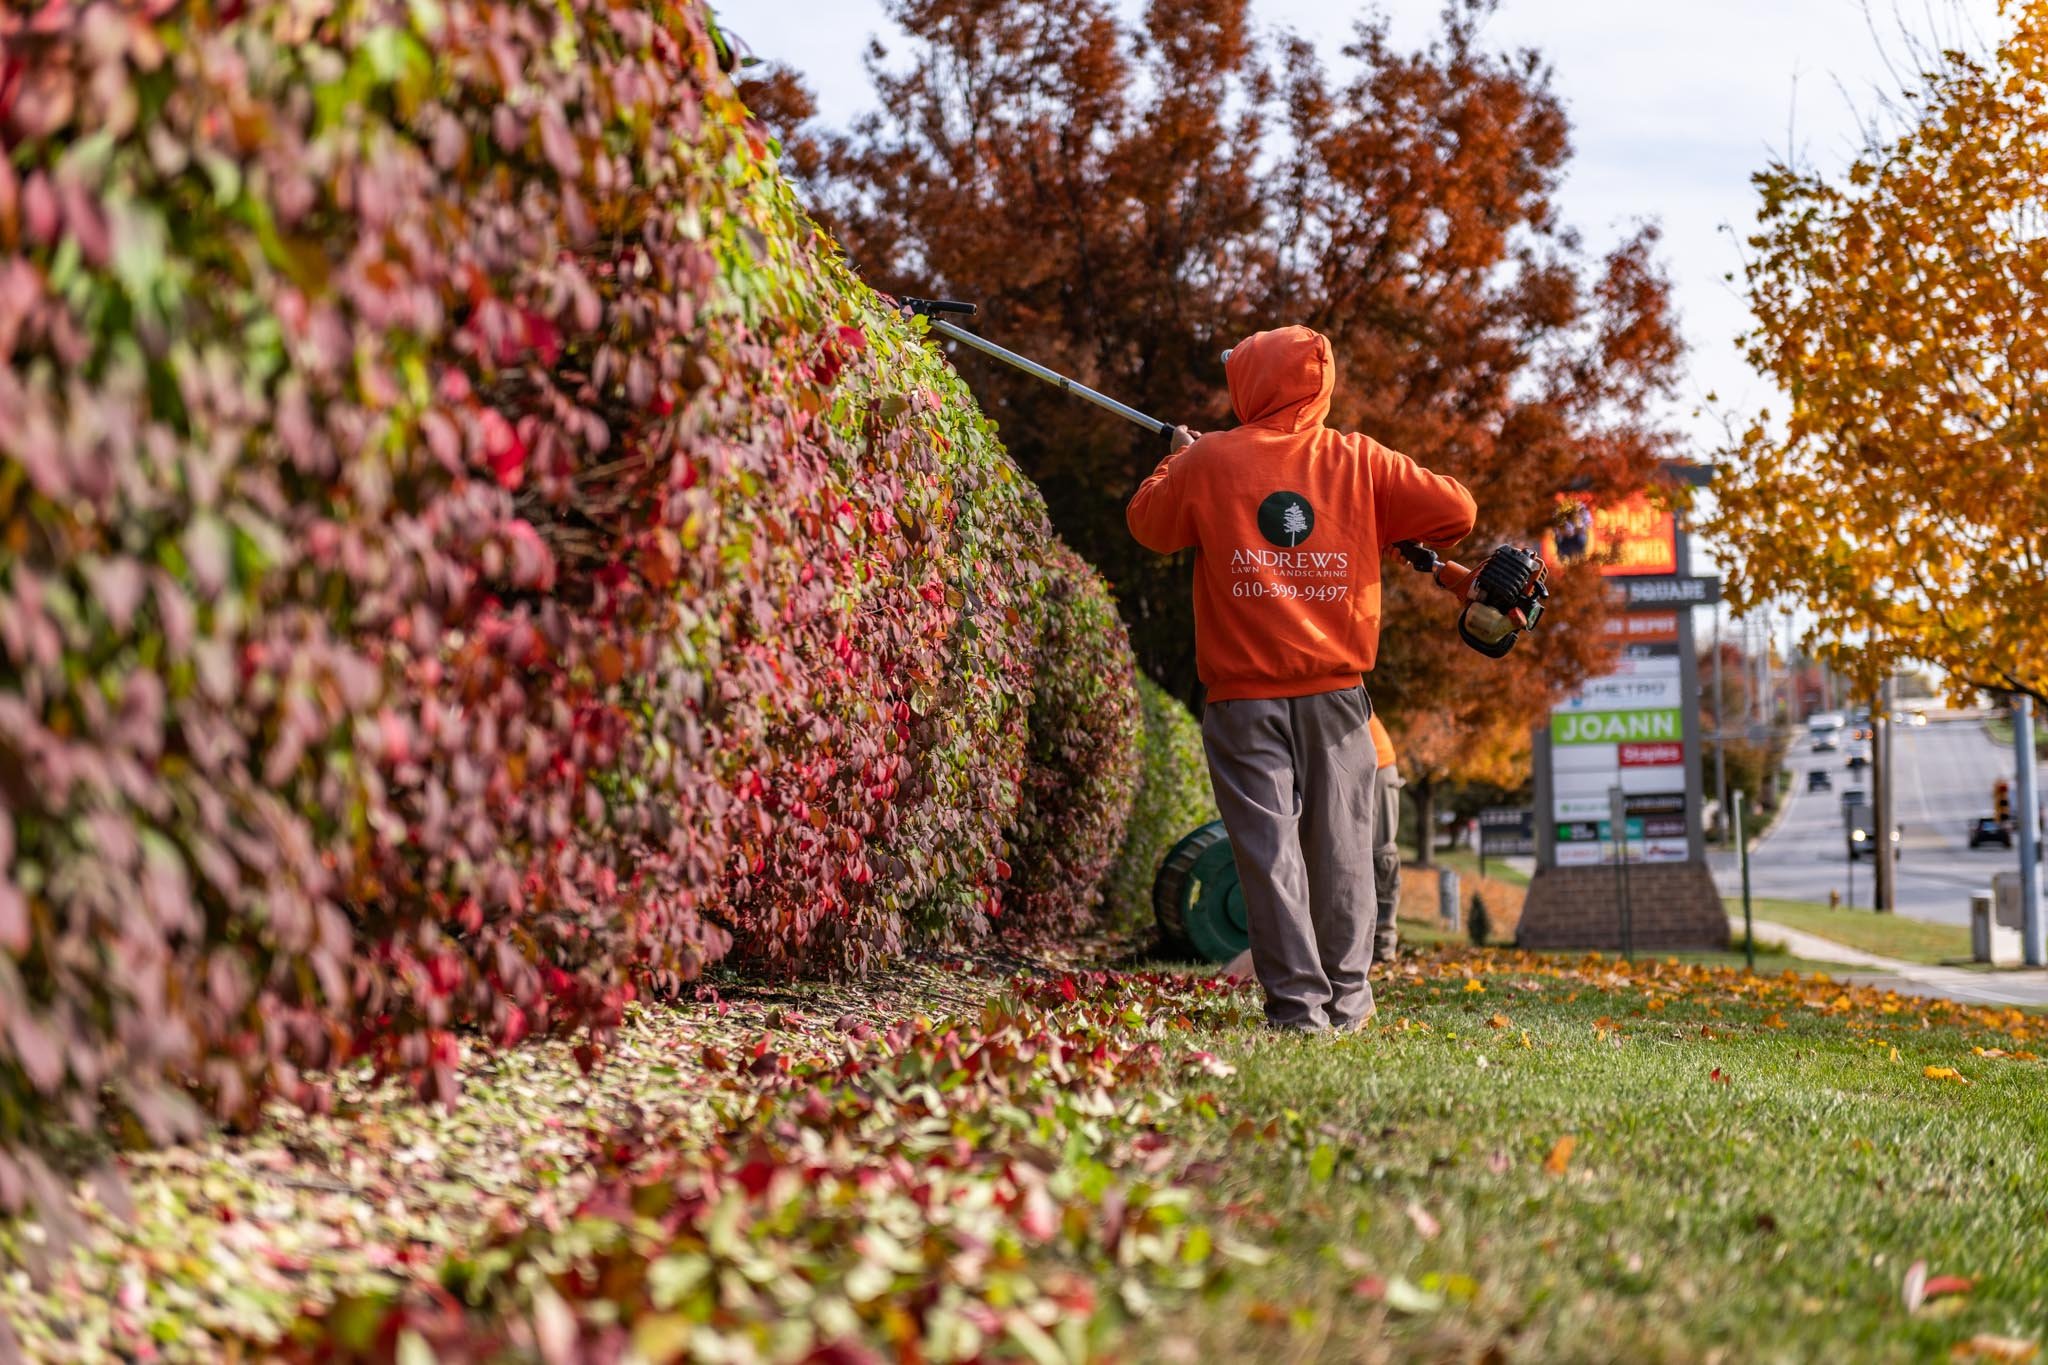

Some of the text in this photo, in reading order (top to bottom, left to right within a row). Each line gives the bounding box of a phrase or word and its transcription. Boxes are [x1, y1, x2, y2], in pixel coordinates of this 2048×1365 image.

[1231, 549, 1348, 569] ANDREW'S
[1231, 566, 1348, 578] LAWN LANDSCAPING
[1232, 581, 1348, 602] 610-399-9497
[1630, 581, 1706, 600] SQUARE
[1561, 712, 1674, 741] JOANN
[1623, 745, 1681, 763] Staples
